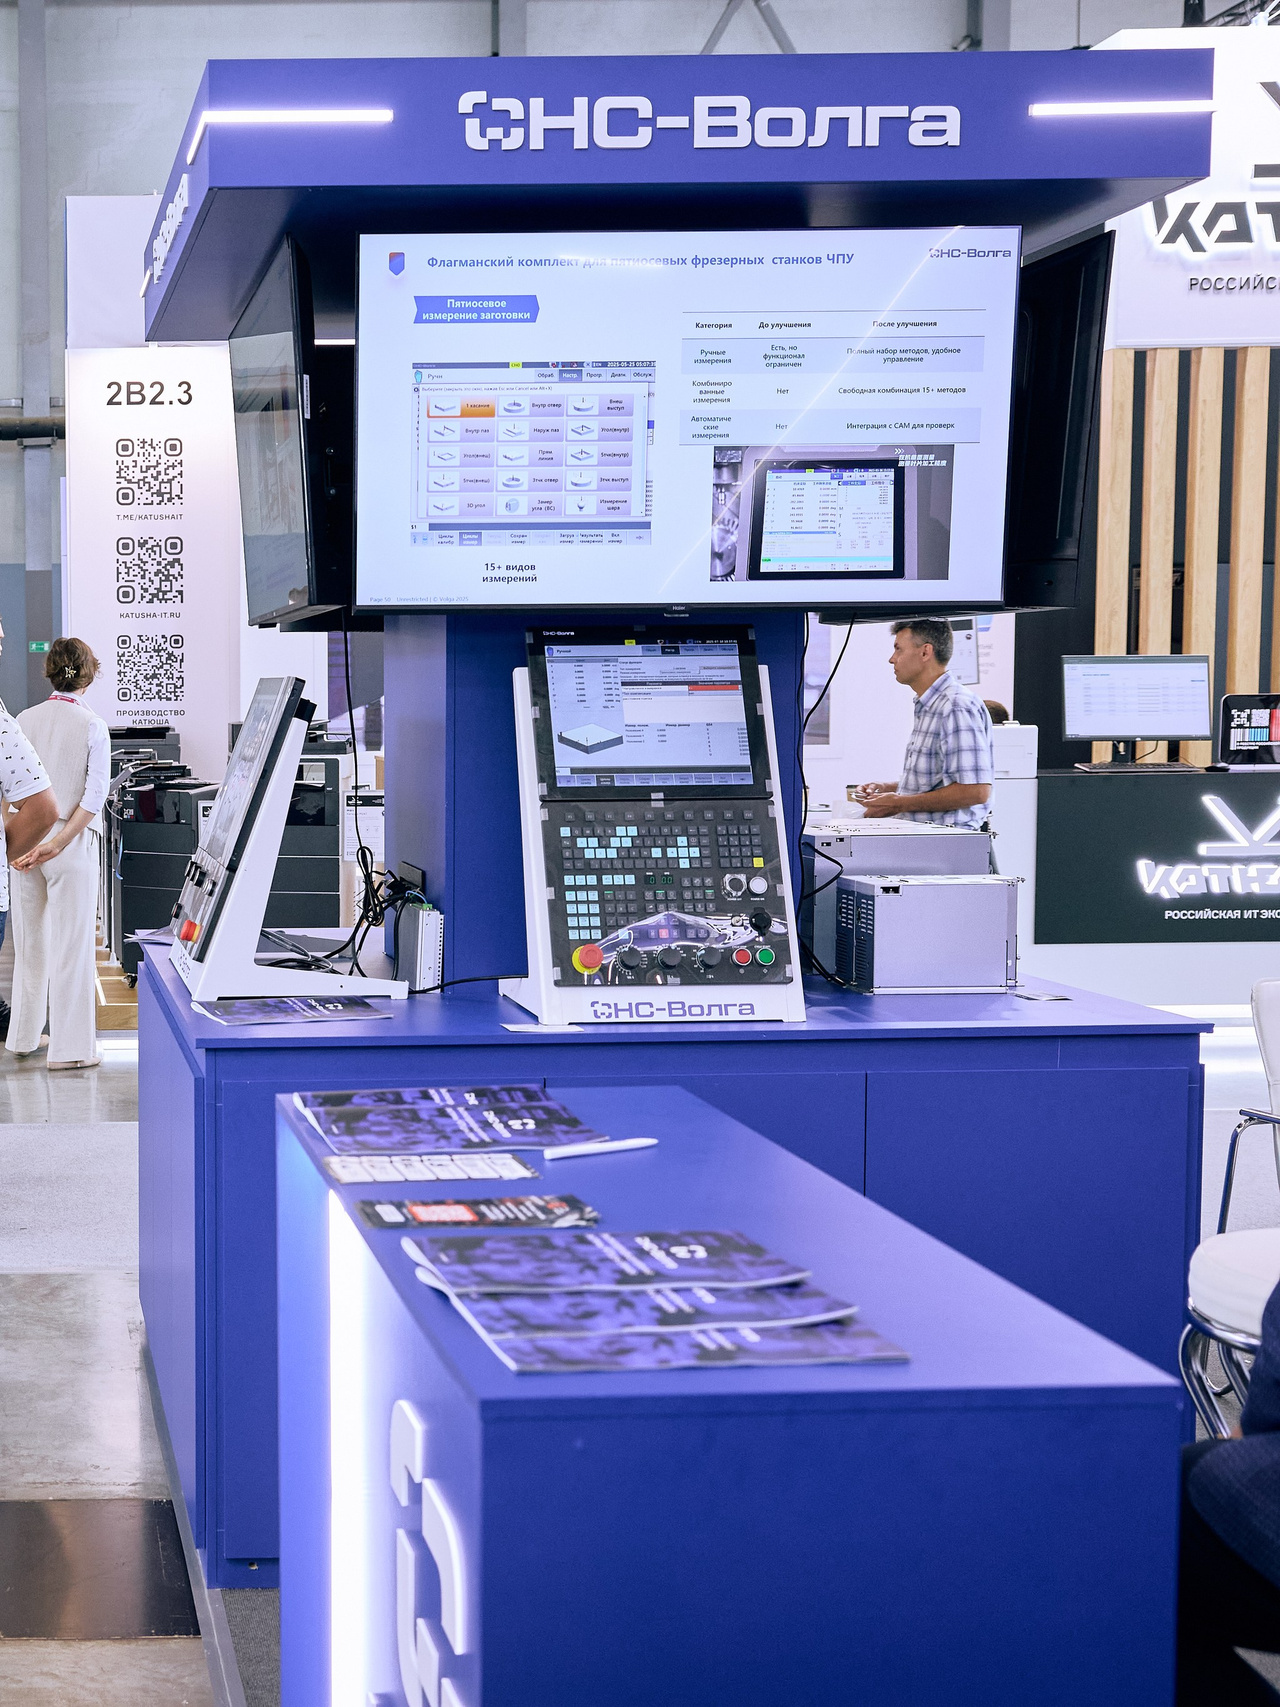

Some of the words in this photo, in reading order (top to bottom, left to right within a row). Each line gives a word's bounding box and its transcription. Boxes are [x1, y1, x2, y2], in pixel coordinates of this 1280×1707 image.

[427, 256, 514, 268] Флагманский
[518, 258, 581, 268] комплект
[611, 256, 687, 267] пятиосевых
[691, 254, 764, 268] фрезерных
[772, 255, 822, 265] станков
[827, 253, 854, 264] ЧПУ
[447, 299, 506, 308] Пятиосевое
[423, 311, 479, 321] измерение
[480, 310, 530, 320] заготовки
[695, 322, 733, 330] Категория
[758, 322, 769, 330] До
[770, 322, 812, 330] улучшения
[873, 320, 895, 328] После
[896, 321, 938, 329] улучшения
[700, 349, 726, 357] Ручные
[847, 347, 875, 355] Полный
[931, 347, 962, 355] удобное
[694, 357, 732, 365] измерения
[763, 353, 806, 361] функционал
[883, 356, 924, 364] управление
[765, 361, 802, 369] ограничен
[692, 380, 732, 388] Комбиниро
[106, 381, 193, 406] 2B2.3
[838, 387, 876, 395] Свободная
[877, 387, 920, 395] комбинация
[693, 397, 731, 405] измерения
[690, 415, 732, 423] Автоматиче
[846, 423, 887, 431] Интеграция
[116, 513, 183, 521] T.ME/KATUSHAIT
[485, 563, 503, 571] 15+
[505, 563, 536, 572] видов
[482, 573, 537, 584] измерений
[1164, 908, 1241, 920] РОССИЙСКАЯ
[1243, 909, 1259, 919] ИТ
